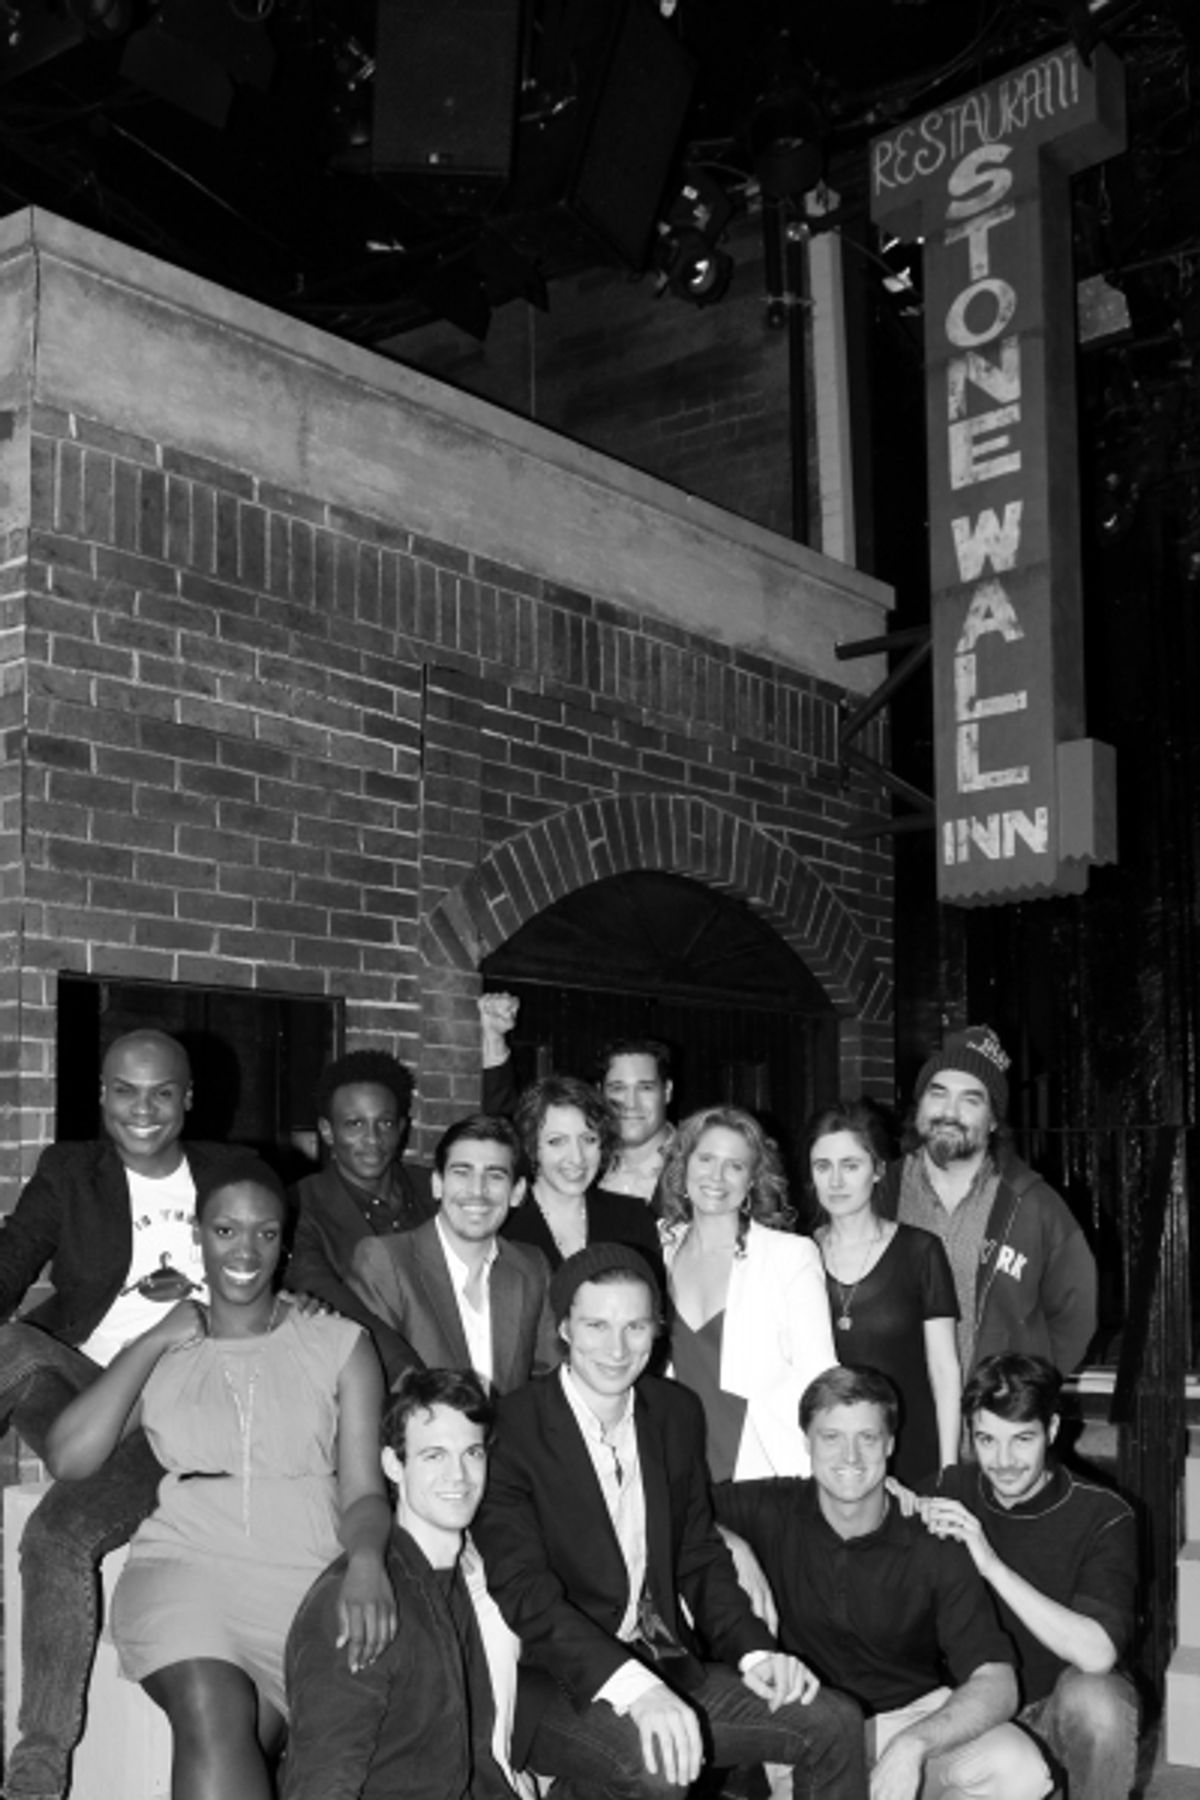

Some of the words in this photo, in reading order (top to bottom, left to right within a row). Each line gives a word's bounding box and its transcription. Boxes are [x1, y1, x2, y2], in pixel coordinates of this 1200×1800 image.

[873, 47, 1079, 196] RESTAURANT
[945, 143, 1030, 794] STONEWALL
[943, 806, 1049, 865] INN
